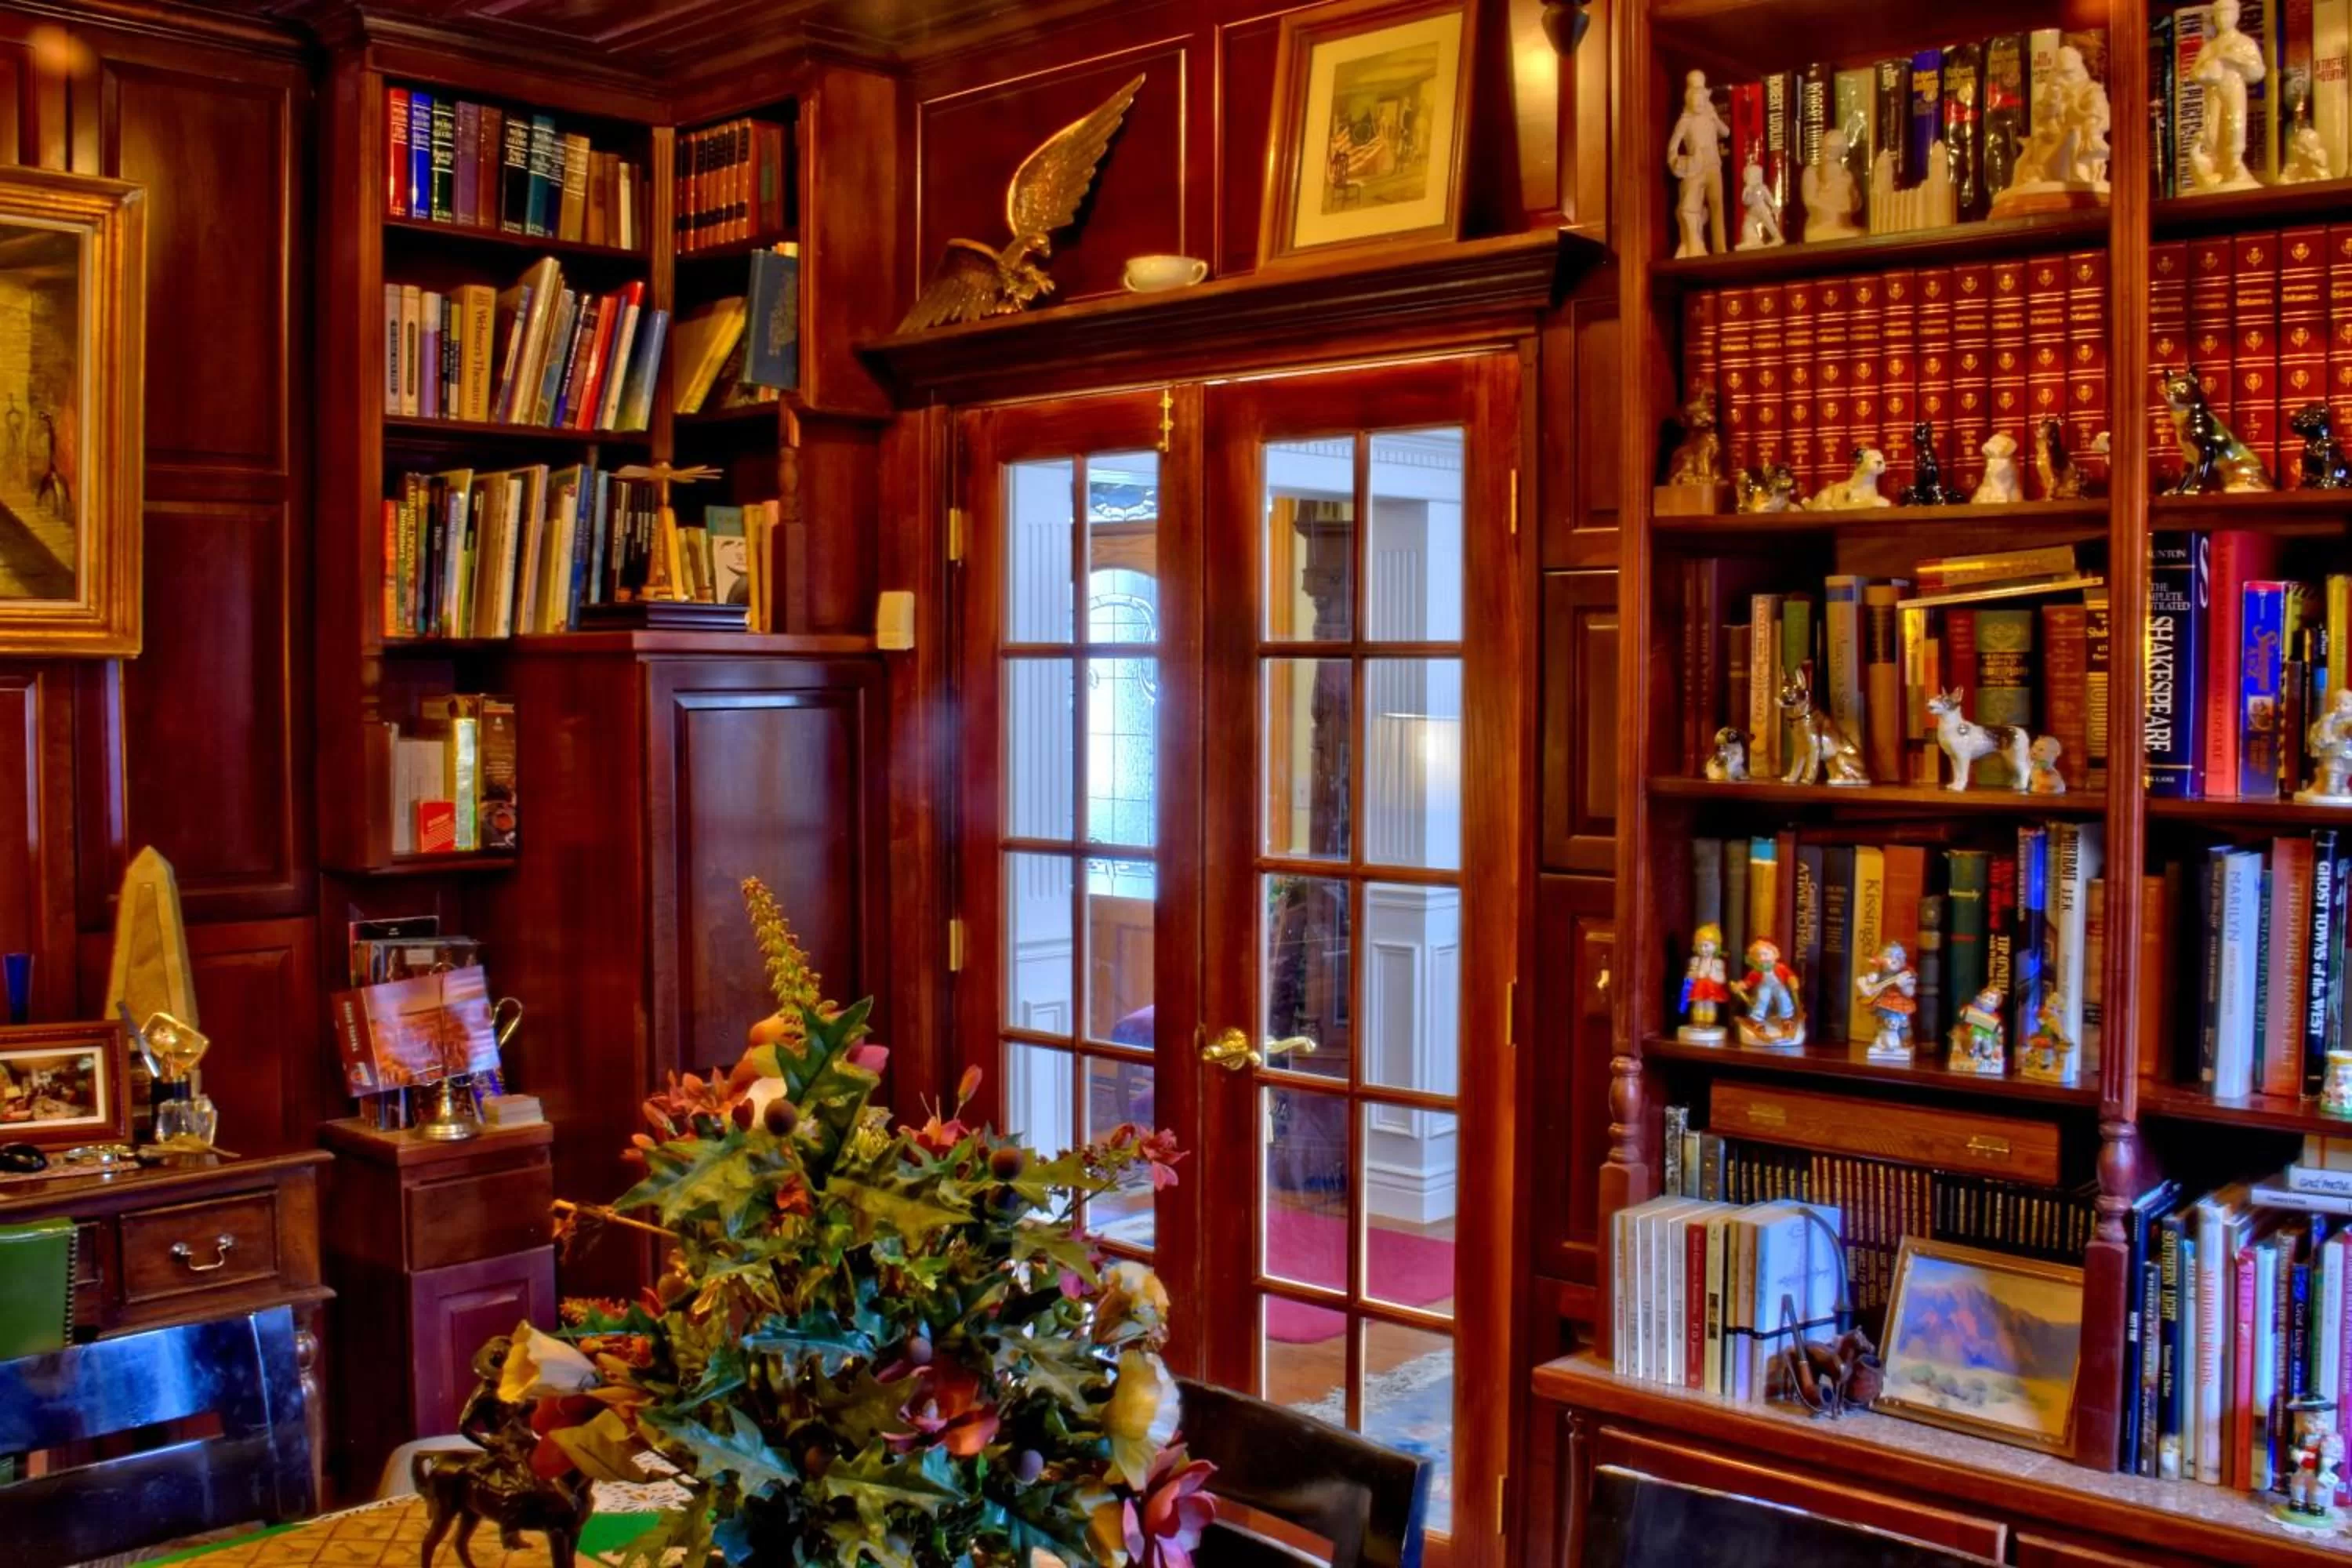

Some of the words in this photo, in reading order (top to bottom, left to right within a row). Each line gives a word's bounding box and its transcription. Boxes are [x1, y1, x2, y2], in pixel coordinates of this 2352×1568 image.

[2180, 13, 2202, 34] KEN
[1769, 74, 1784, 111] ROBERT
[1804, 82, 1824, 122] ROBERT
[2180, 88, 2205, 122] PLACE
[1769, 112, 1784, 151] LUDLUM
[2151, 583, 2169, 592] THE
[2145, 615, 2175, 753] SHAKESPEARE
[2061, 831, 2078, 881] PORTRAIT
[1796, 874, 1809, 907] TIME
[2314, 860, 2332, 911] GHOST
[1860, 878, 1881, 957] Kissinger
[2227, 870, 2242, 942] MARILYN
[2284, 880, 2303, 971] THEODORE
[1997, 935, 2009, 954] TIP
[2312, 911, 2330, 960] TOWNS
[2311, 977, 2328, 998] the
[2312, 962, 2327, 978] of
[2281, 974, 2298, 1068] ROOSEVELT
[2309, 997, 2326, 1037] WEST
[2162, 1229, 2178, 1287] SOUTHERN
[2161, 1288, 2176, 1322] LIGHT
